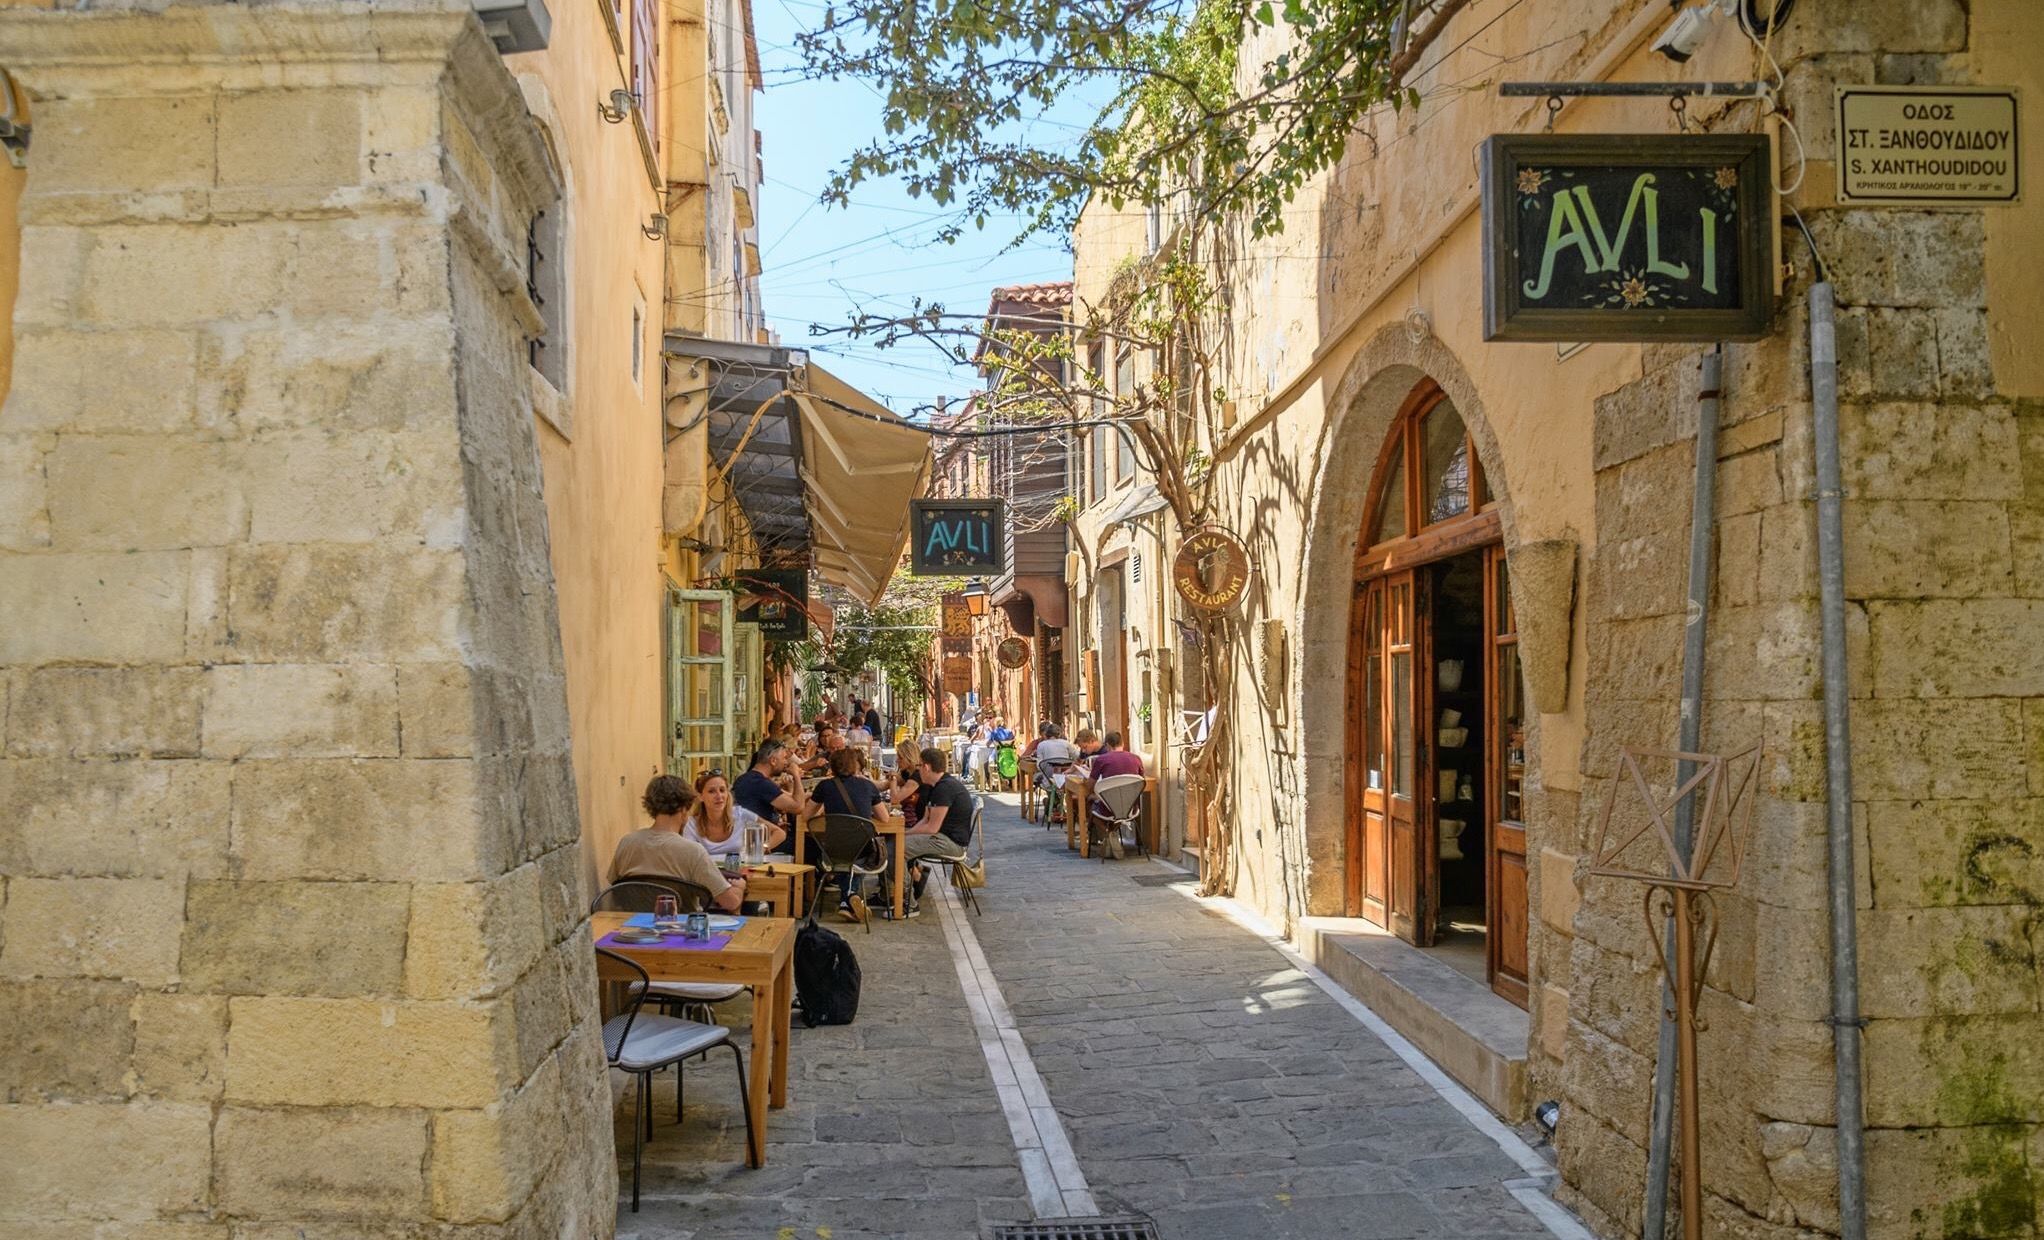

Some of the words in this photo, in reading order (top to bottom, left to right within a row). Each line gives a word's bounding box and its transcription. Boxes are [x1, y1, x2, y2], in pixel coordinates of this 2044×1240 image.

[1903, 104, 1955, 120] ΟΔΟΣ
[1848, 129, 1874, 149] ΣΤ.
[1879, 130, 2009, 150] ΞΑΝΘΟΥΔΙΔΟΥ
[1851, 158, 1866, 175] S.
[1871, 159, 2007, 176] XANTHOUDIDOU
[1523, 173, 1718, 299] AVLI
[925, 520, 990, 557] AVLI
[1180, 575, 1243, 605] RESTAURANT
